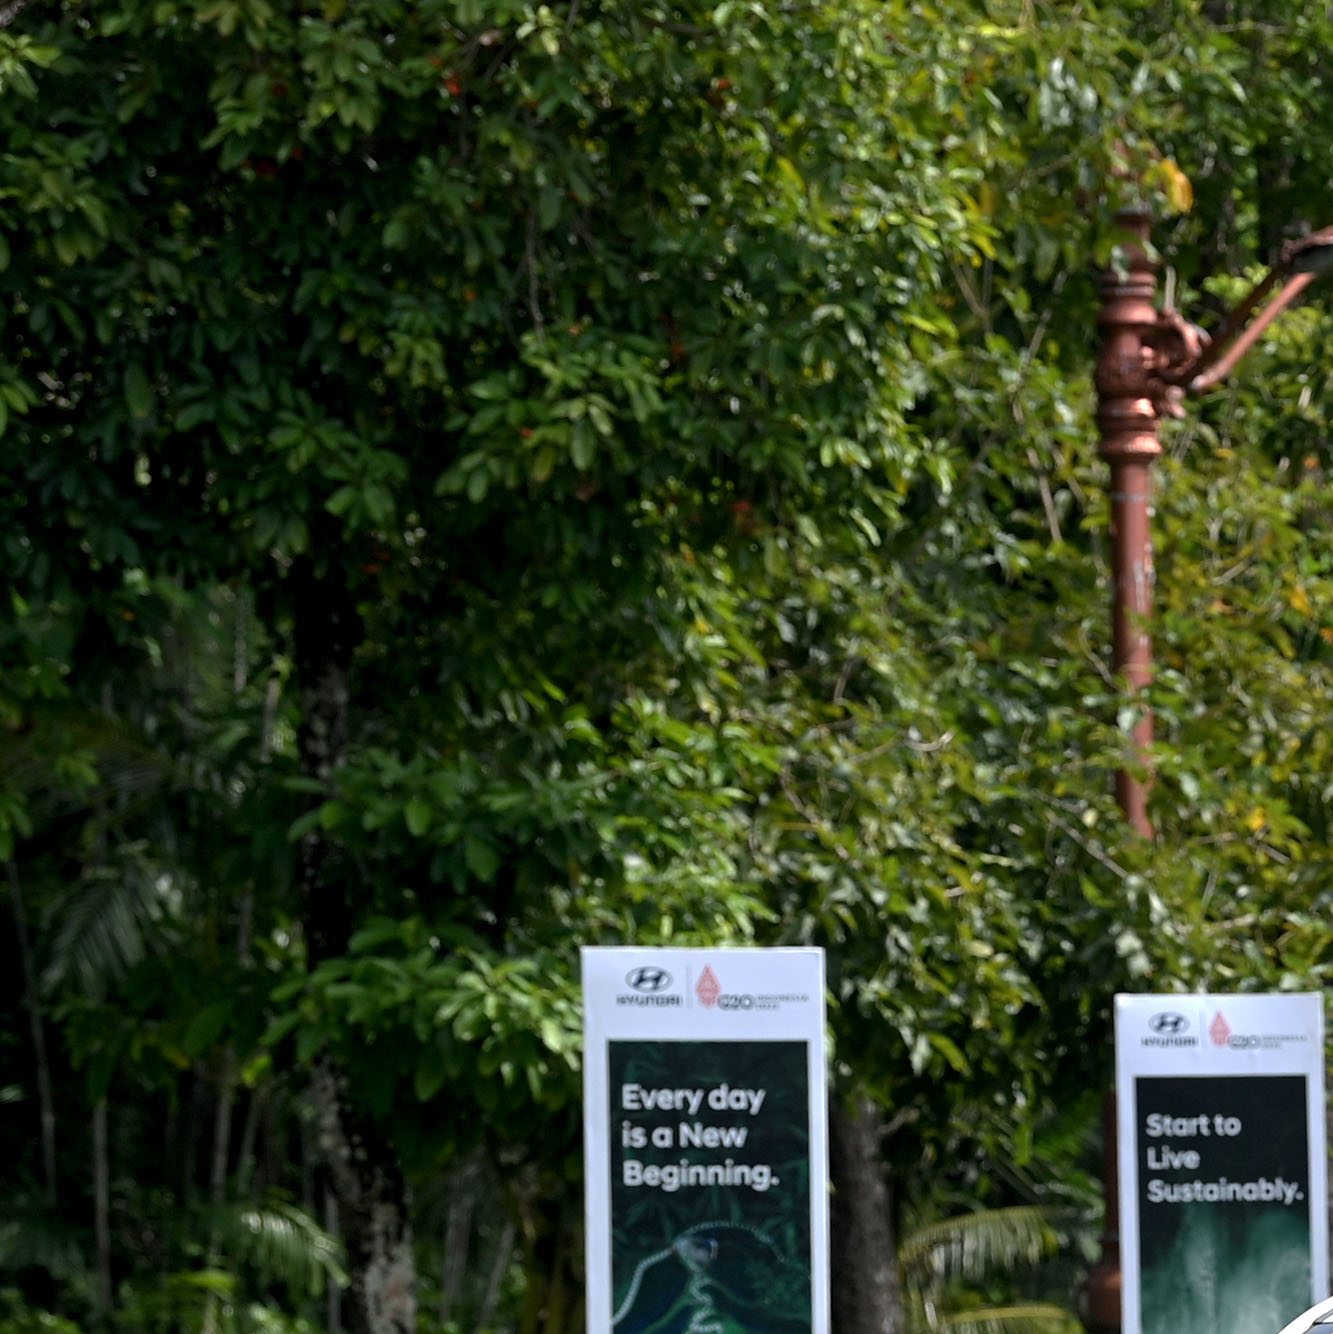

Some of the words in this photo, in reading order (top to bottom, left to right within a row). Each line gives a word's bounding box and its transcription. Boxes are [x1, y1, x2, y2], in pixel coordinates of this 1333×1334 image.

[622, 1083, 704, 1115] Every
[707, 1082, 767, 1115] day
[622, 1120, 648, 1149] is
[652, 1126, 674, 1149] a
[678, 1121, 749, 1149] New
[1145, 1113, 1211, 1137] Start
[1213, 1113, 1242, 1137] to
[1146, 1145, 1200, 1170] Live
[623, 1158, 780, 1192] Beginning.
[1147, 1176, 1305, 1206] Sustainably.
